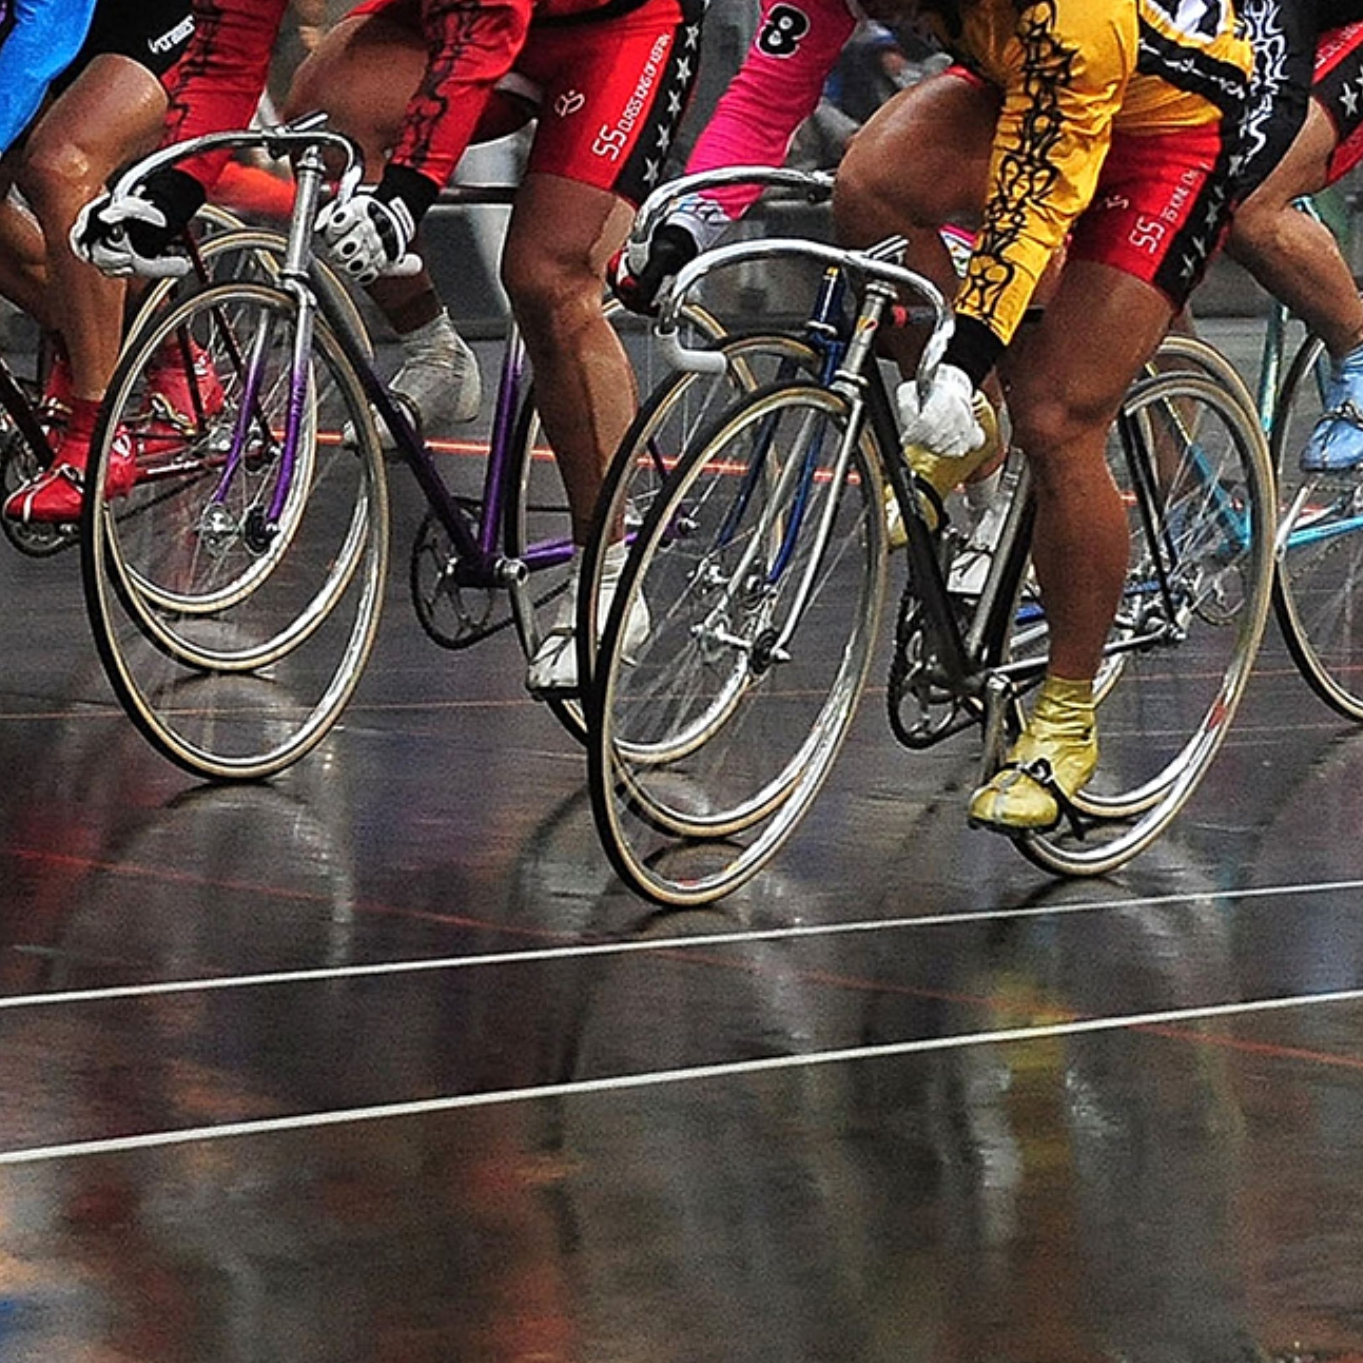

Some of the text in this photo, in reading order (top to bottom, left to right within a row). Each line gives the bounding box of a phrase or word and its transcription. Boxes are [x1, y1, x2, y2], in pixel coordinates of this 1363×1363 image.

[756, 3, 811, 58] 8
[592, 124, 627, 161] SS
[1128, 216, 1165, 254] SS
